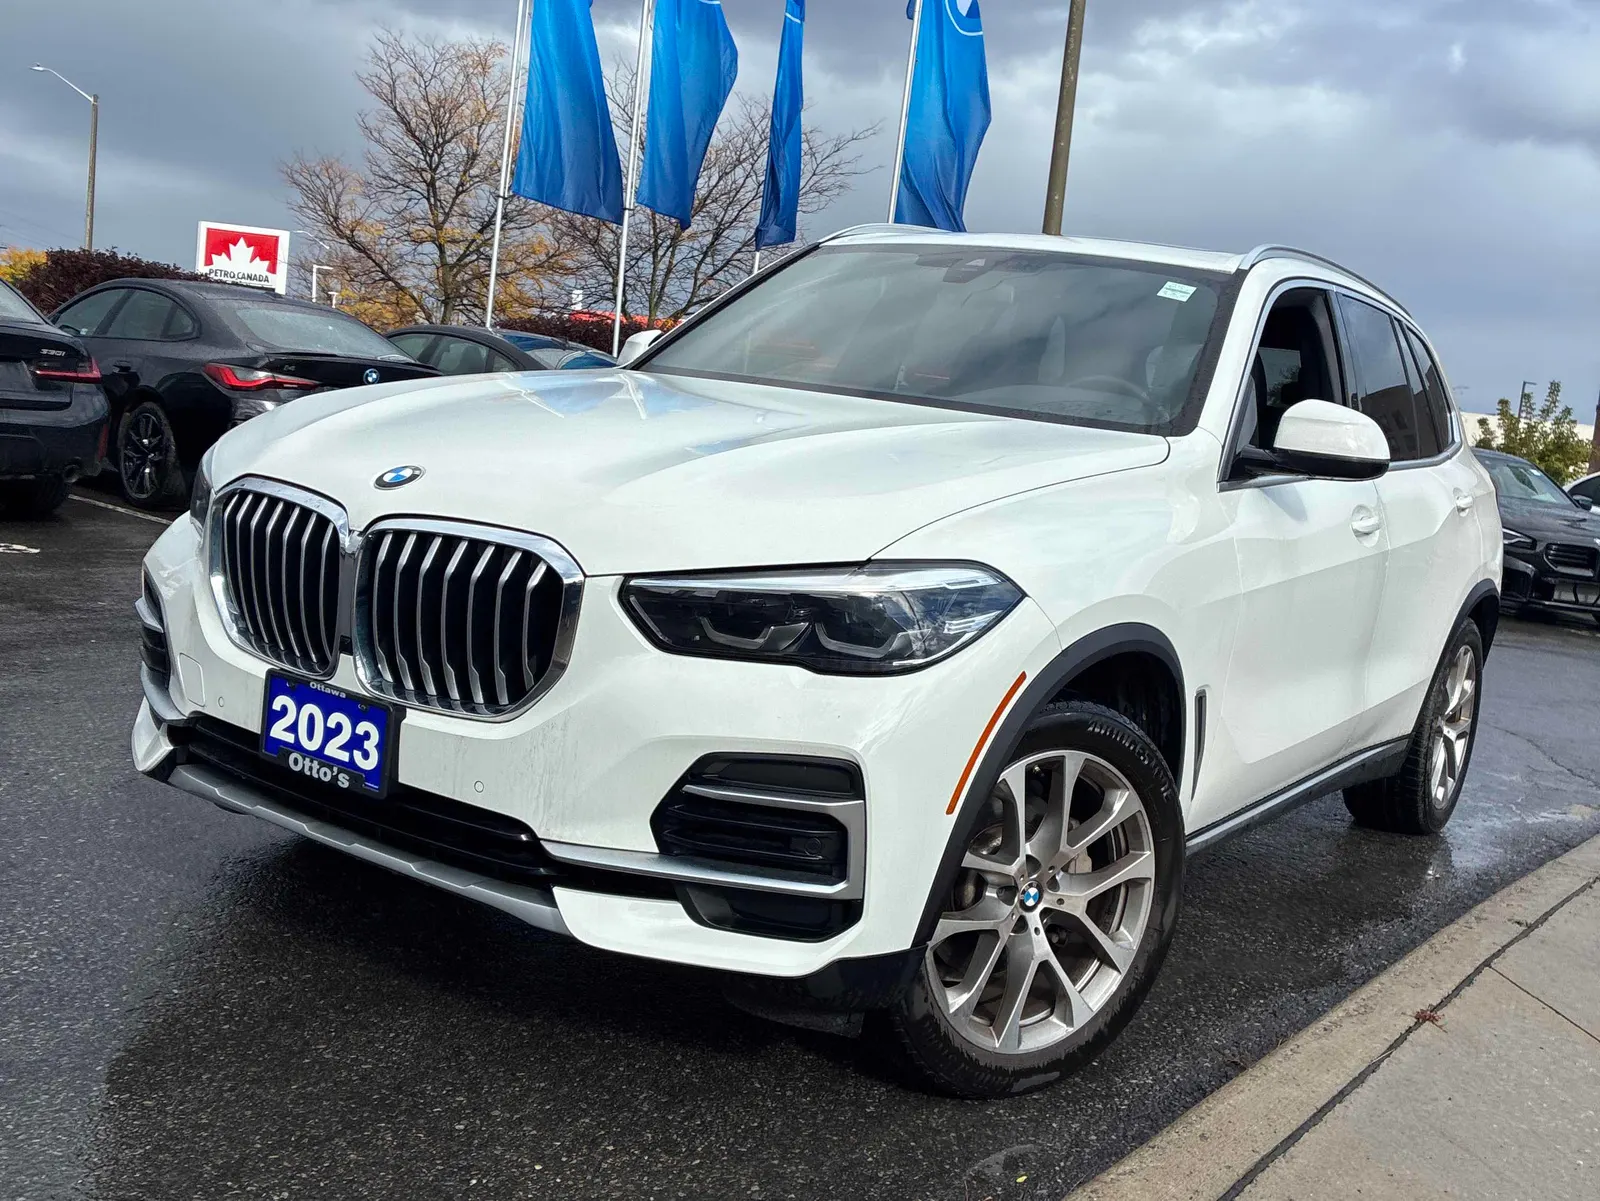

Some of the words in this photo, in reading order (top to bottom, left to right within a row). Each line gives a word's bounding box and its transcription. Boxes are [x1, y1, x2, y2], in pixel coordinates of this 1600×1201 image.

[208, 268, 236, 279] PETRO
[237, 271, 270, 283] CANADA
[309, 681, 347, 699] Ottawa
[269, 695, 380, 771] 2023
[288, 752, 350, 789] Otto's
